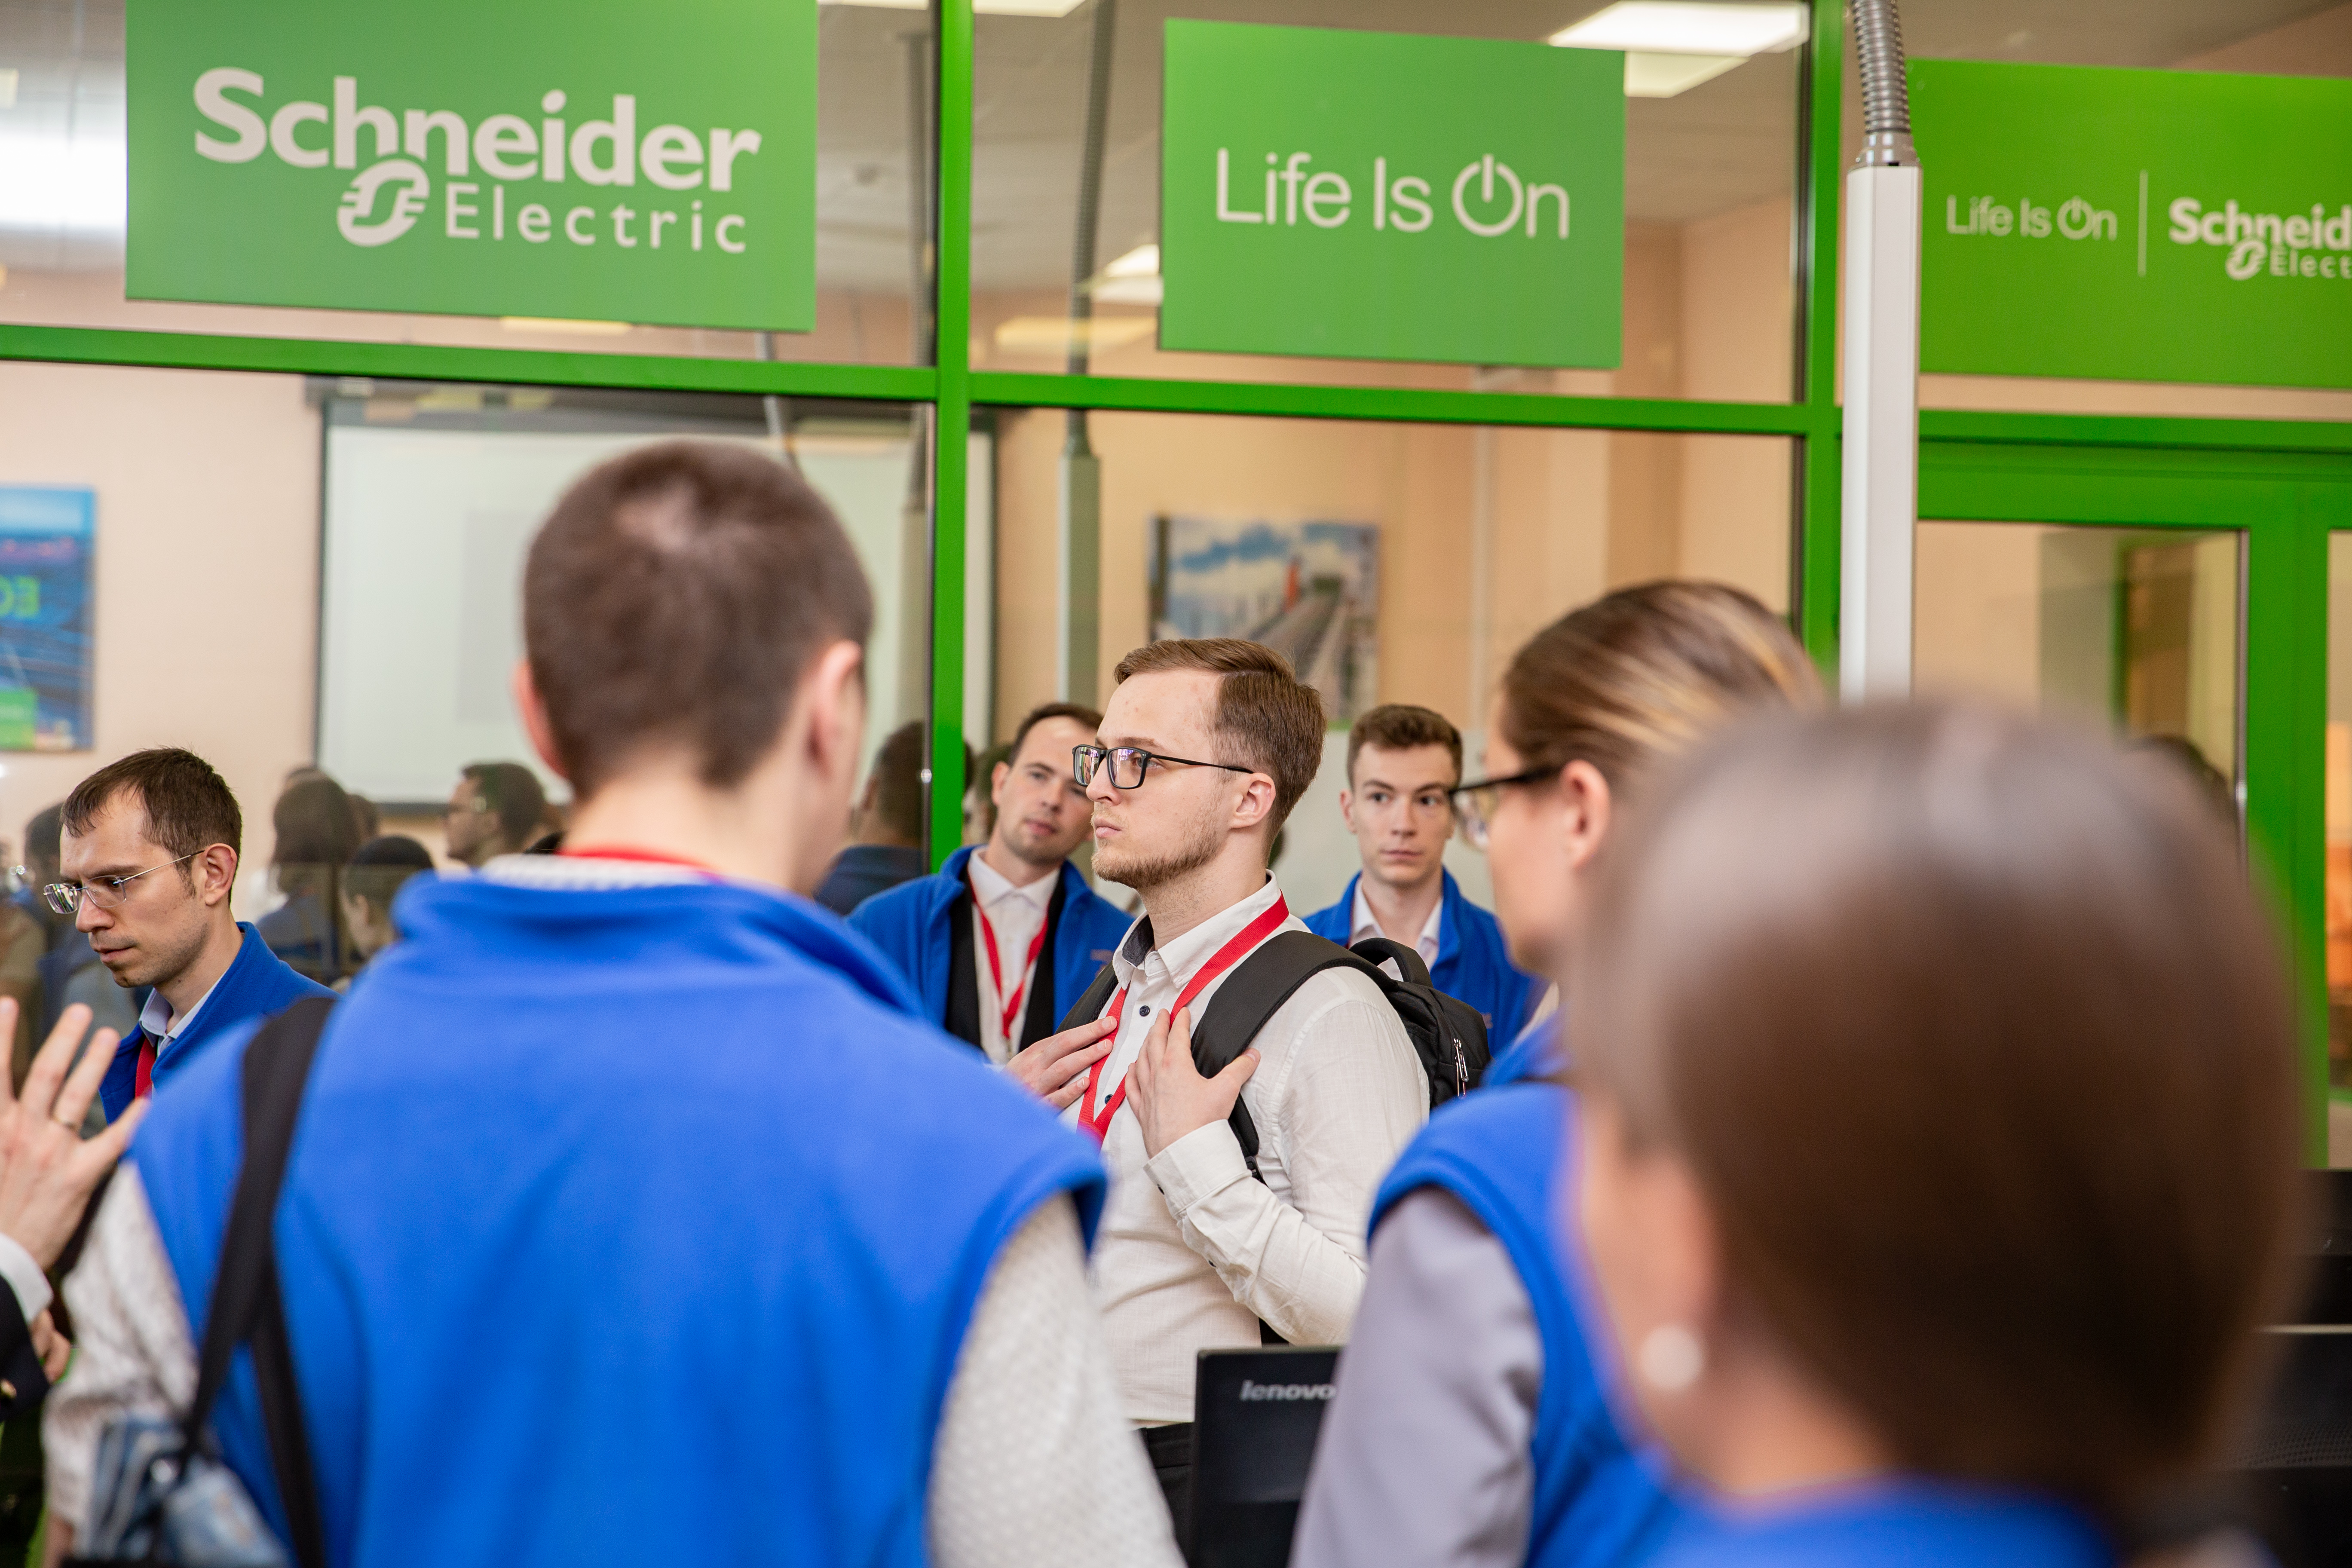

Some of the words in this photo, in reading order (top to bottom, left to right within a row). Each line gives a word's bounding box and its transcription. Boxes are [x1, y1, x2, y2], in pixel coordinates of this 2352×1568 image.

[193, 66, 763, 192] Schneider
[446, 182, 746, 254] Electric
[1216, 148, 1352, 228] Life
[1374, 156, 1434, 233] Is
[1451, 153, 1570, 239] On
[1946, 194, 2013, 236] Life
[2019, 197, 2052, 239] Is
[2056, 196, 2118, 241] On
[2168, 196, 2352, 251] Schneid
[2269, 247, 2352, 280] Elect
[1240, 1379, 1336, 1401] lenovo
